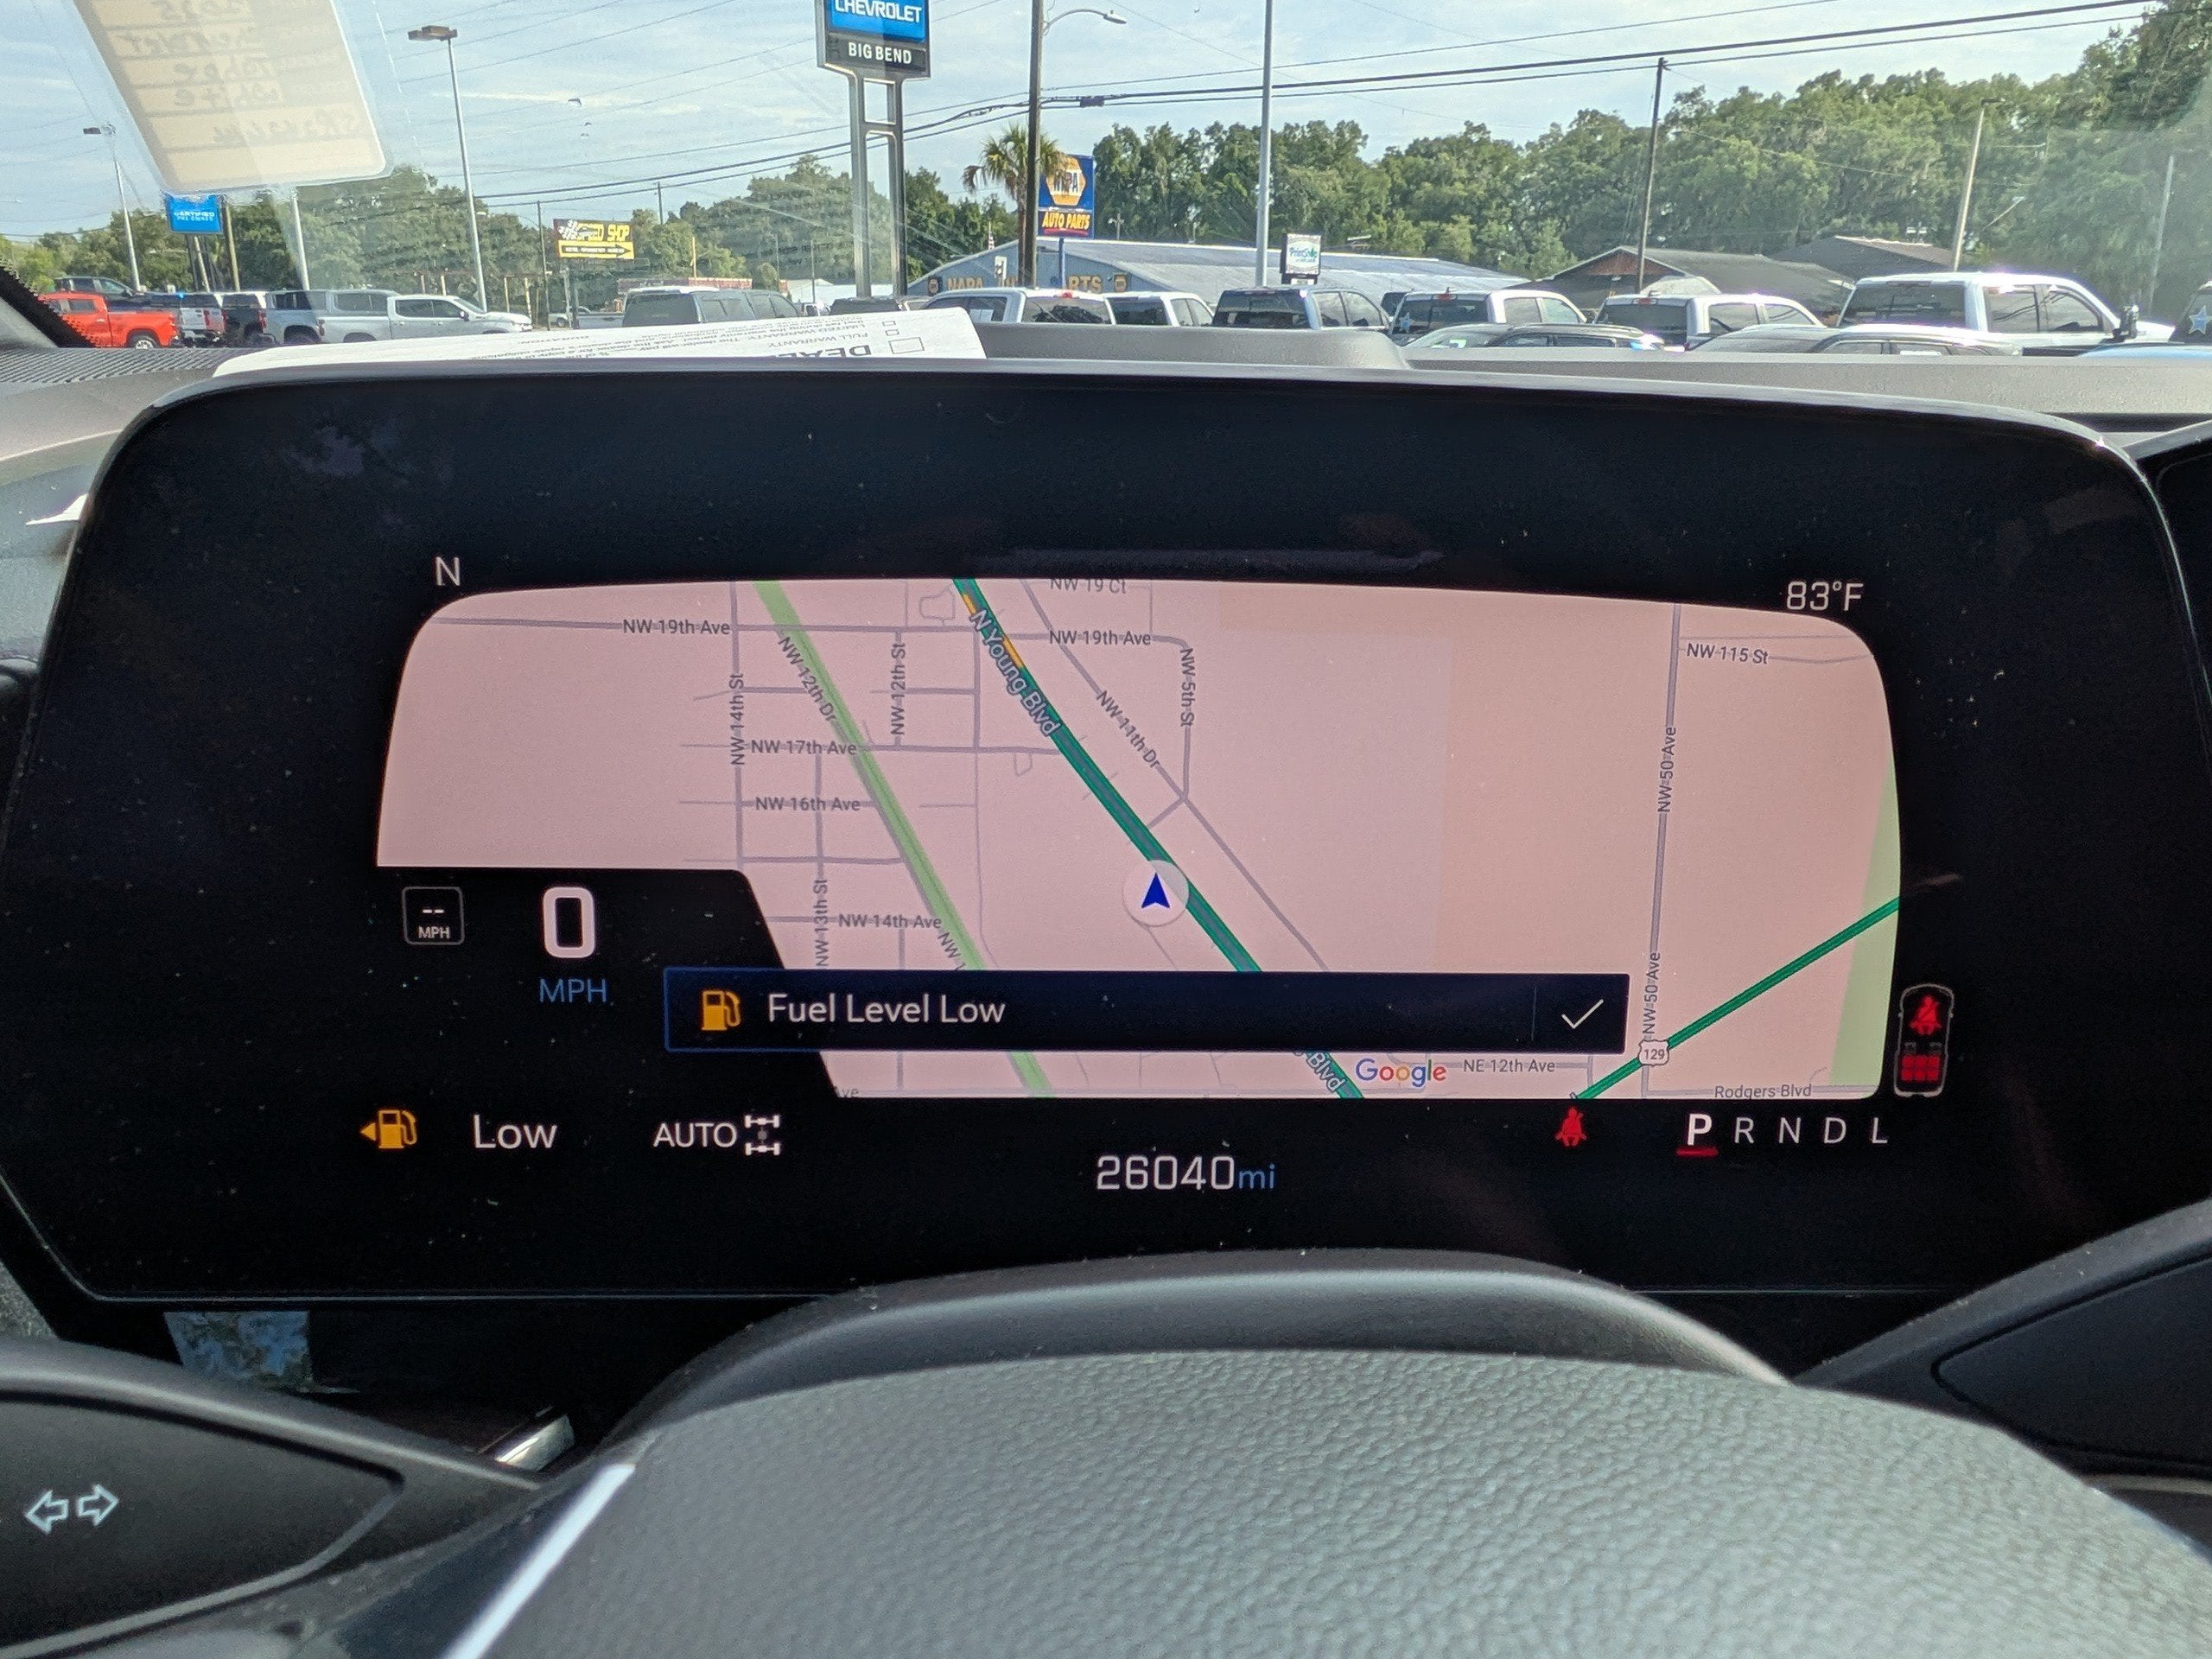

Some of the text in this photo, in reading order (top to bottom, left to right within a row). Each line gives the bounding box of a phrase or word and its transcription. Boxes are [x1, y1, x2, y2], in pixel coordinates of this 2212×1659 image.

[835, 0, 922, 22] CHEVROLET
[848, 41, 912, 65] BIG BEND
[607, 224, 630, 241] SHOP
[1042, 212, 1090, 230] AUTO PARTS
[947, 276, 983, 290] NAPA
[435, 556, 461, 587] N
[1050, 579, 1079, 590] NW
[623, 619, 731, 635] NW 19th Ave
[1050, 631, 1152, 645] NW 19th Ave
[1687, 643, 1769, 664] NW 115 St
[778, 636, 837, 721] NW 12th Dr
[969, 609, 1061, 738] N Young Blvd
[891, 643, 906, 735] NW 12th St
[1179, 647, 1196, 727] NW 5th St
[728, 673, 745, 765] NW 14th St
[1096, 690, 1160, 768] NW 11th Dr
[751, 740, 857, 755] NW 17th Ave
[1657, 727, 1676, 812] NW 50 Ave
[755, 797, 861, 811] NW 16th Ave
[418, 925, 450, 939] MPH
[543, 887, 595, 958] 0
[813, 880, 829, 967] NW 13th St
[839, 913, 942, 929] NW 14th Ave
[938, 931, 962, 958] NW
[539, 977, 607, 1002] MPH
[1643, 952, 1661, 1034] NW 50 Ave
[767, 995, 1006, 1024] Fuel Level Low
[1464, 1058, 1556, 1073] NE 12th Ave
[1643, 1048, 1665, 1060] 129
[1306, 1052, 1346, 1092] Blvd
[1355, 1058, 1447, 1088] Google
[1714, 1084, 1812, 1100] Rodgers Blvd
[474, 1115, 557, 1148] Low
[653, 1122, 738, 1148] AUTO
[1688, 1113, 1888, 1147] P R N D L
